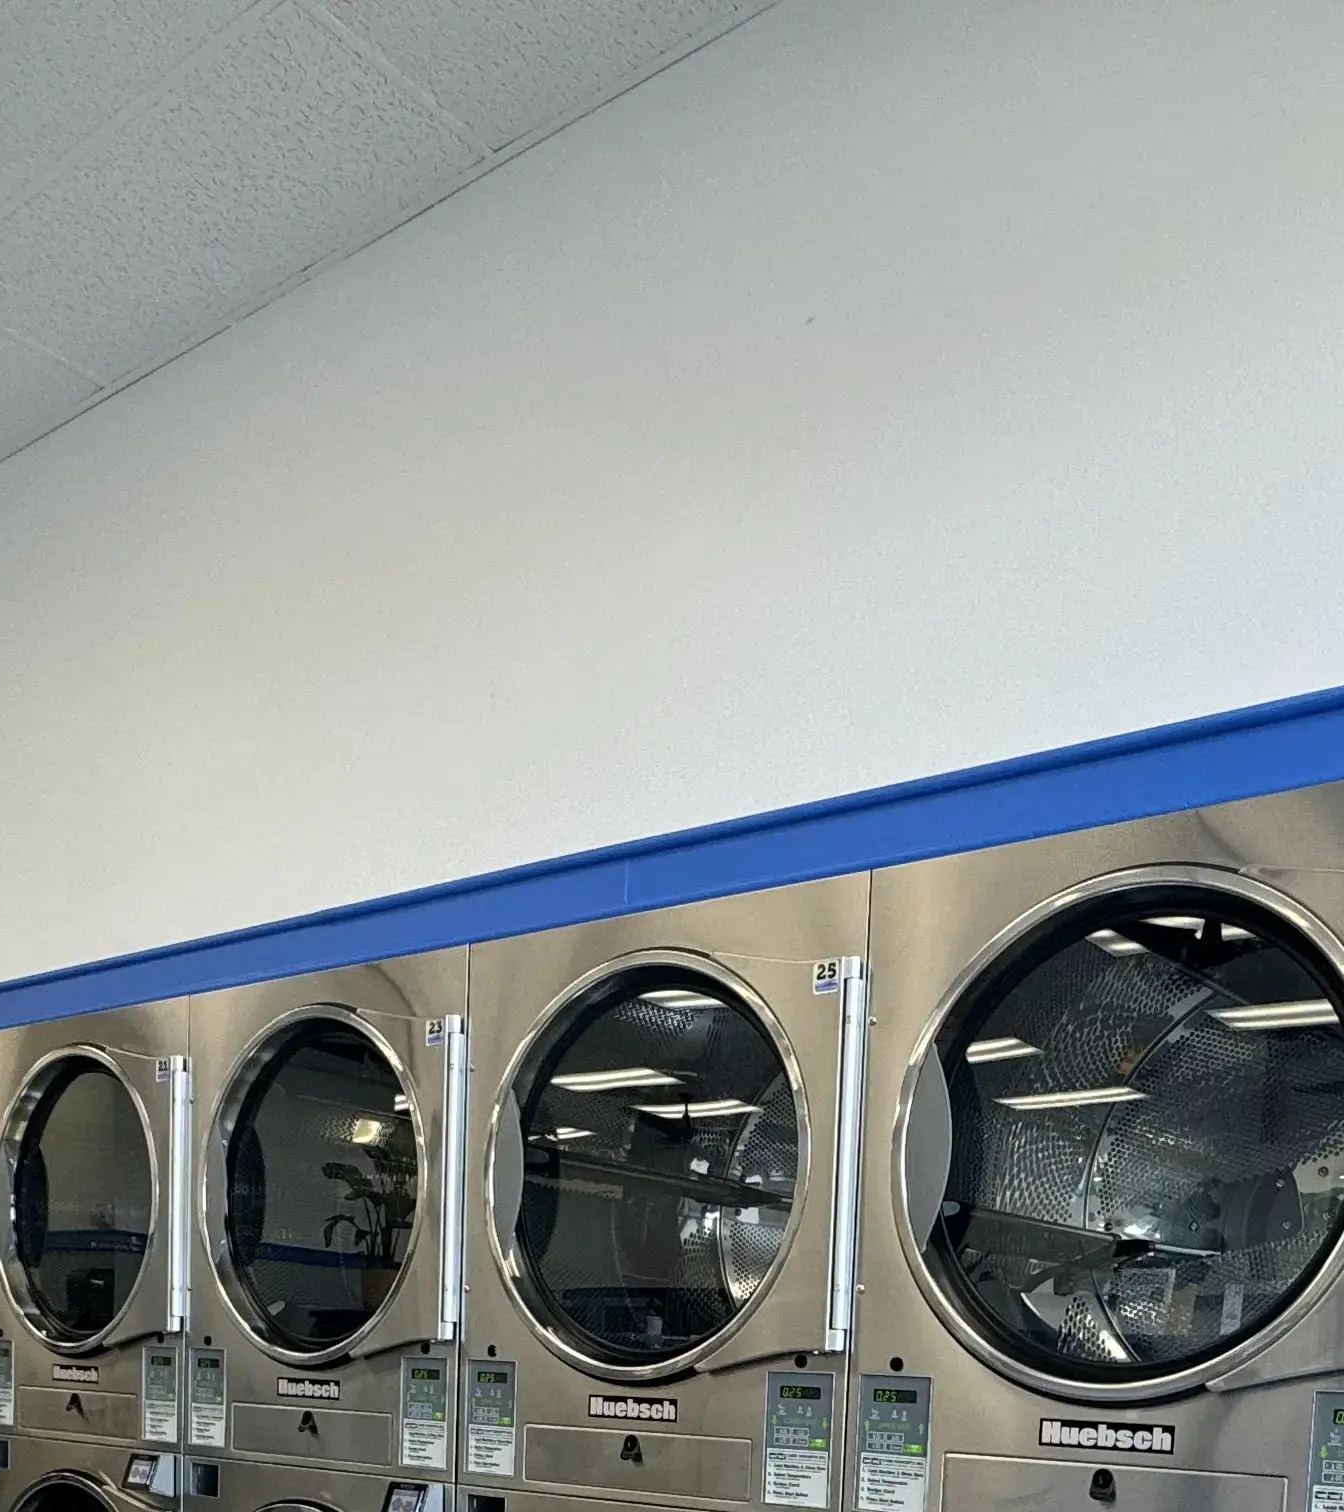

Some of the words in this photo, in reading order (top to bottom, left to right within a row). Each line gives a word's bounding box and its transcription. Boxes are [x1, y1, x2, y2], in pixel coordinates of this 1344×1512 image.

[816, 962, 836, 980] 25
[429, 1020, 442, 1034] 23
[590, 1396, 676, 1420] Huebsch
[1041, 1420, 1172, 1451] Huebsch
